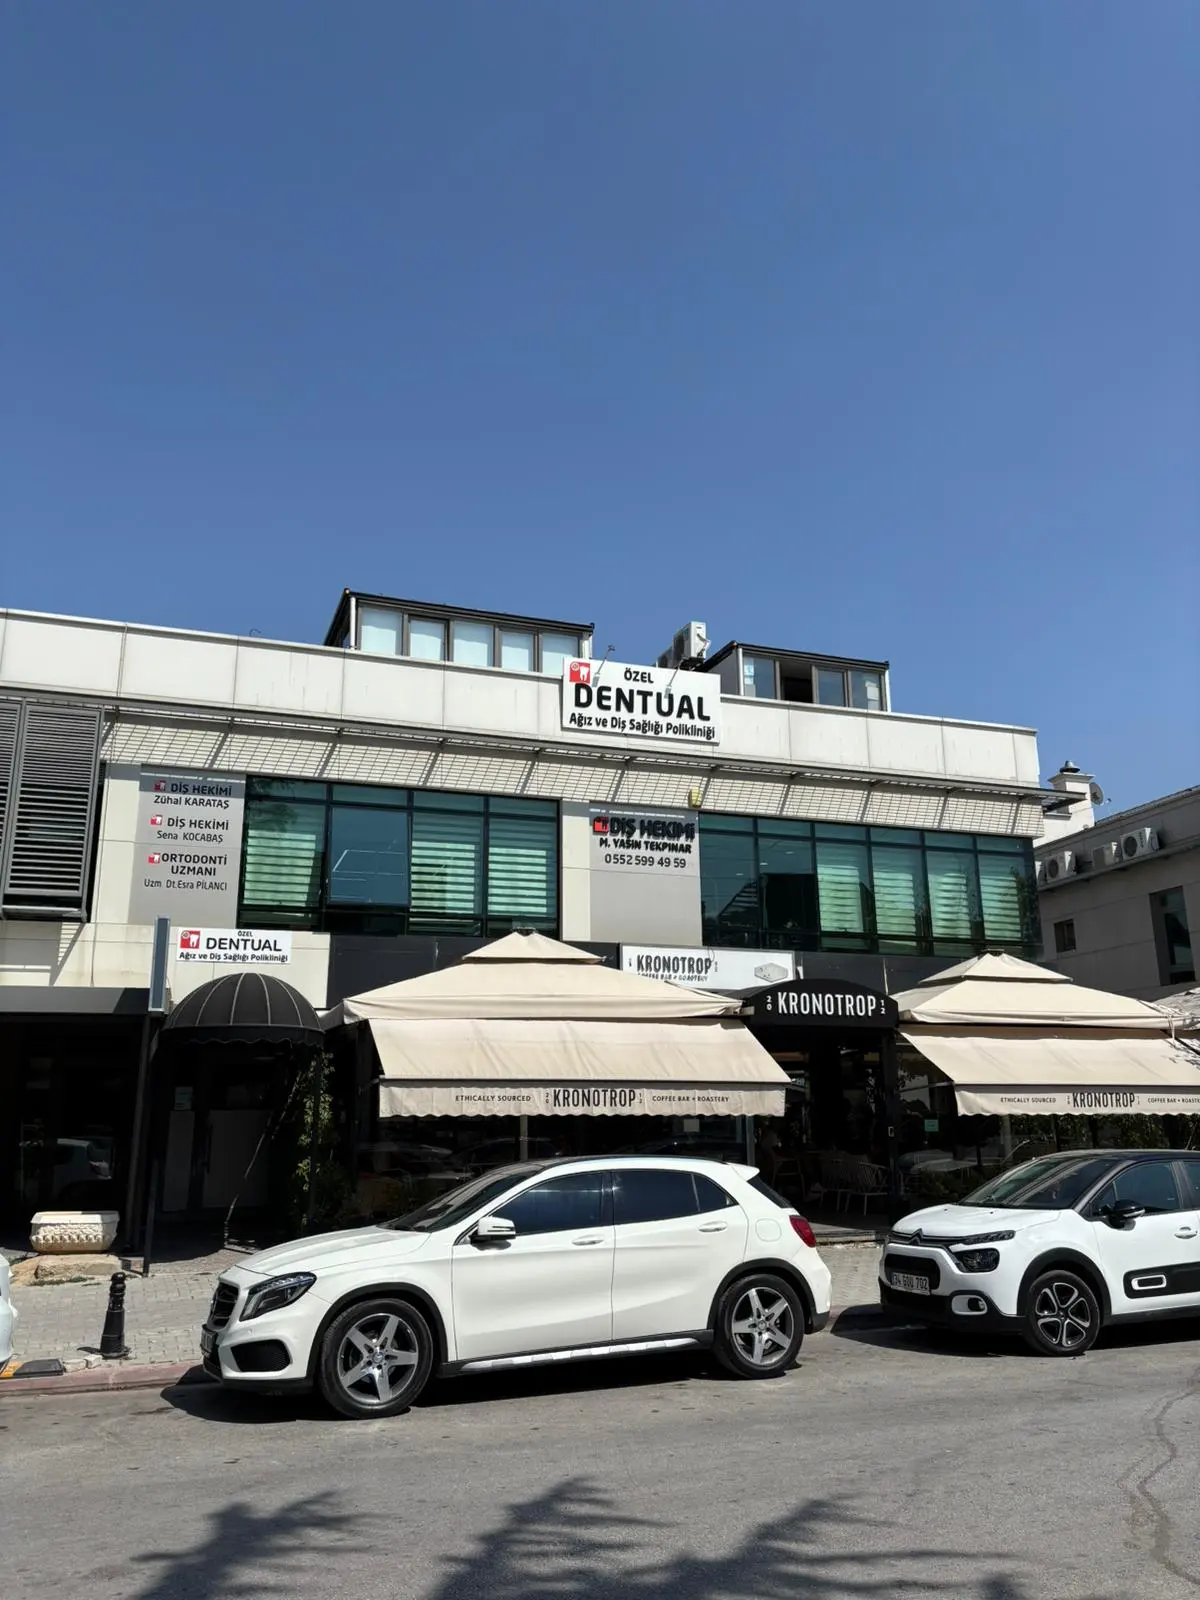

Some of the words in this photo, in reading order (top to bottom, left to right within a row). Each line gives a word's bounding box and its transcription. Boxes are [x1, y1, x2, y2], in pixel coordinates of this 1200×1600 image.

[624, 667, 654, 684] ÖZEL
[574, 683, 711, 721] DENTUAL
[569, 712, 593, 728] Ağız
[595, 717, 608, 728] ve
[610, 717, 627, 732] Diş
[629, 718, 663, 735] Sağlığı
[666, 723, 715, 740] Polikliniği
[170, 782, 189, 794] DİŞ
[192, 784, 232, 796] HEKİMİ
[184, 797, 230, 810] KARATAŞ
[167, 816, 186, 829] DİŞ
[189, 819, 229, 831] HEKİMİ
[157, 830, 178, 840] Sena
[183, 832, 224, 844] KOCABAŞ
[599, 838, 611, 848] M.
[643, 841, 692, 854] TEKPINAR
[161, 852, 228, 865] ORTODONTİ
[634, 856, 654, 866] 599
[657, 857, 671, 868] 49
[673, 859, 687, 869] 59
[171, 865, 217, 876] UZMANI
[206, 937, 282, 951] DENTUAL
[179, 951, 196, 961] Ağız
[209, 952, 222, 962] Diş
[223, 953, 249, 963] Sağlığı
[250, 953, 288, 963] Polikliniği
[636, 954, 712, 975] KRONOTROP
[777, 991, 877, 1017] KRONOTROP
[553, 1088, 636, 1108] KRONOTROP
[1072, 1092, 1136, 1108] KRONOTROP
